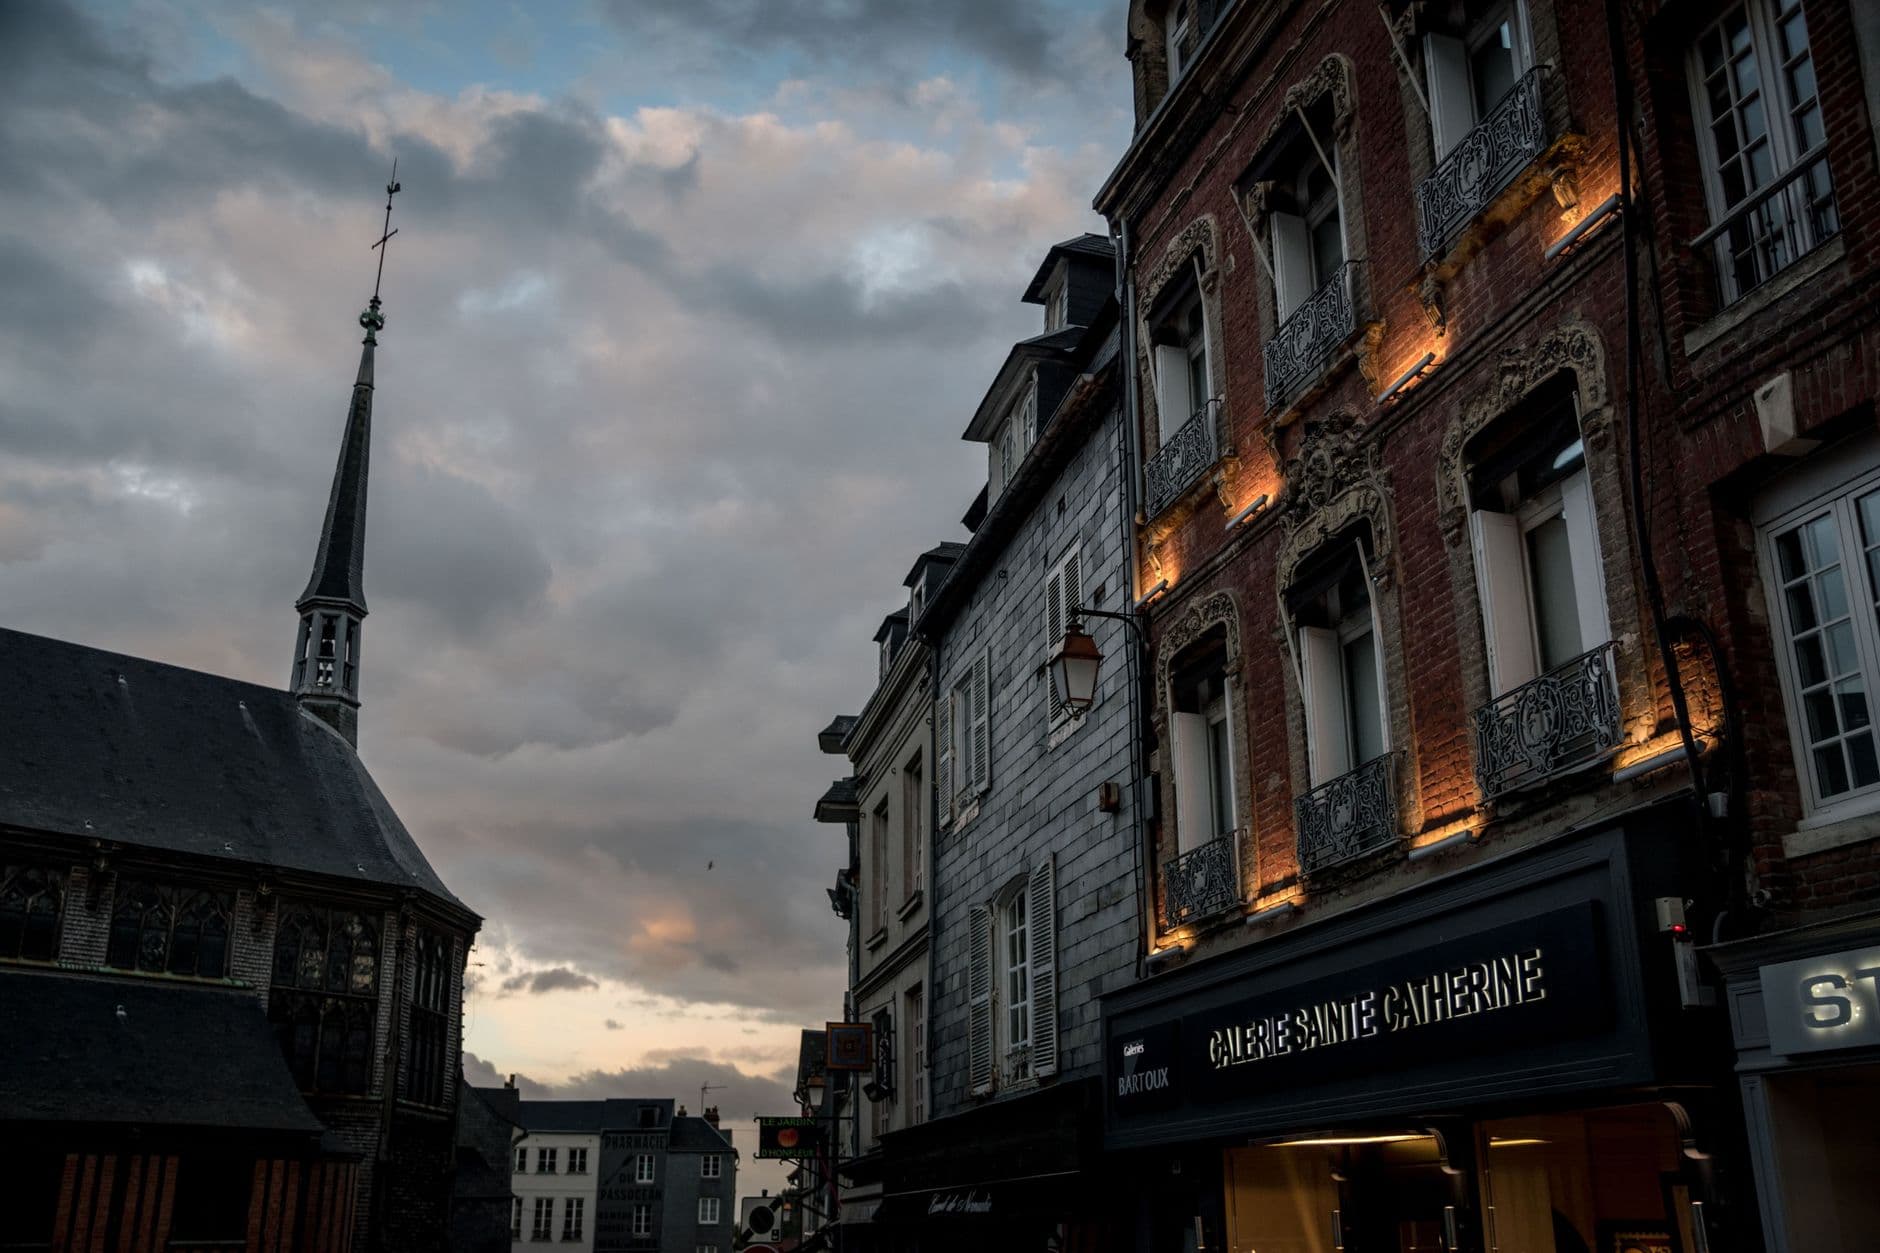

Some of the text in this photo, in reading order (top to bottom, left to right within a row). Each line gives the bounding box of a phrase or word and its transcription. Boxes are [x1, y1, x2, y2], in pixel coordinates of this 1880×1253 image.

[1208, 948, 1548, 1069] GALERIE SAINTE CATHERINE
[1118, 1066, 1169, 1097] BARTOUX
[763, 1118, 816, 1127] LE JARDIN
[604, 1135, 666, 1149] PHARMACIE
